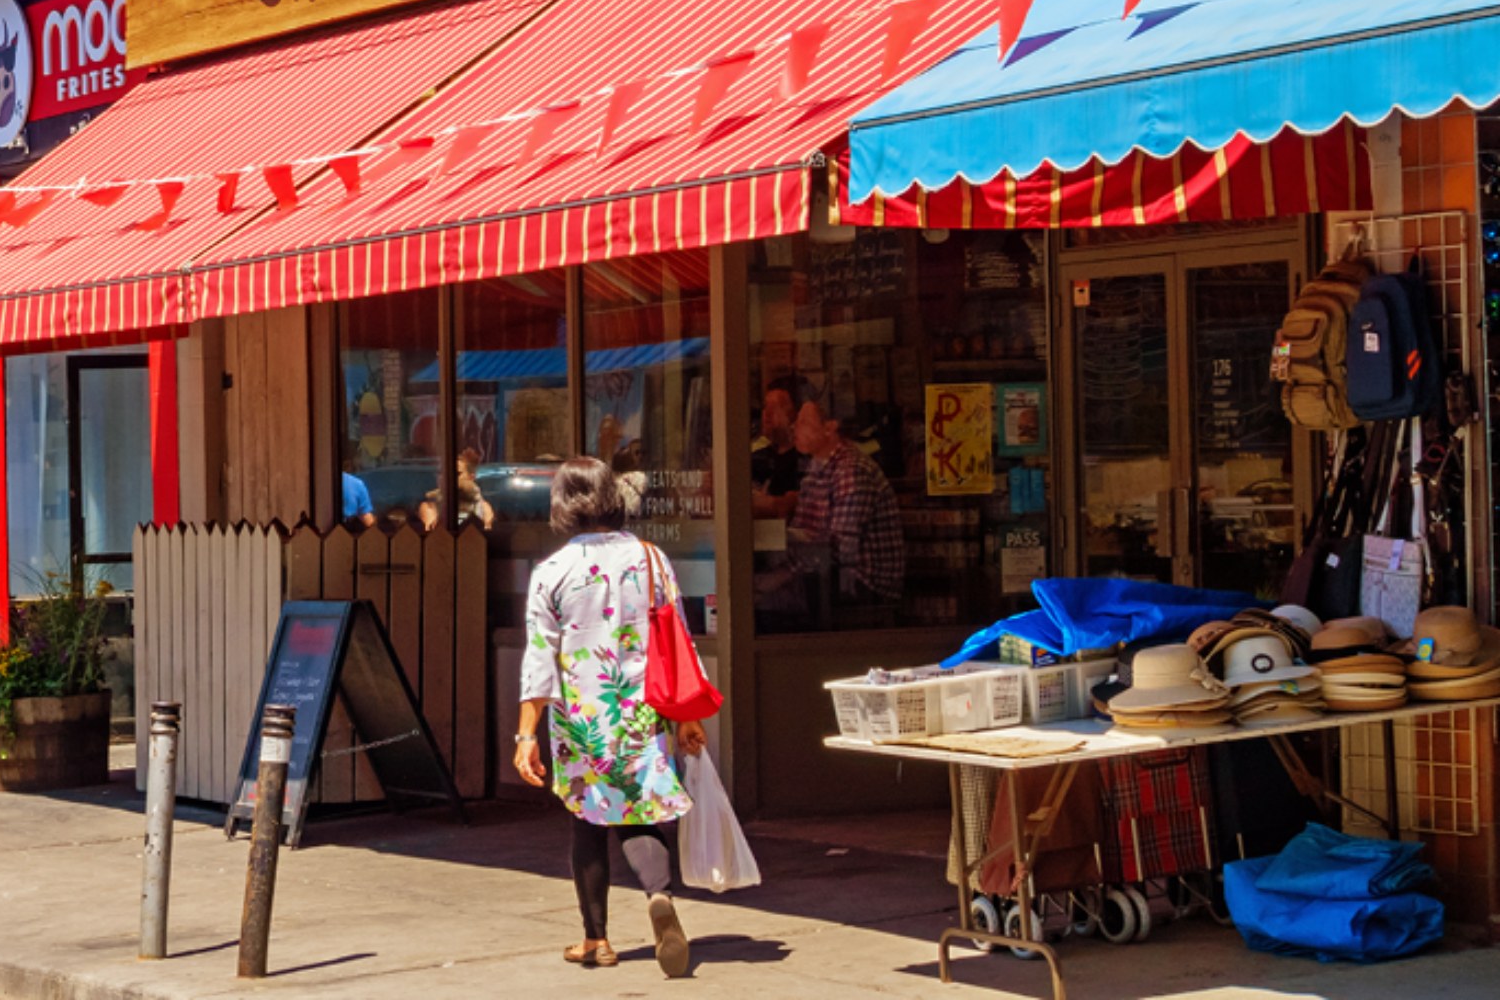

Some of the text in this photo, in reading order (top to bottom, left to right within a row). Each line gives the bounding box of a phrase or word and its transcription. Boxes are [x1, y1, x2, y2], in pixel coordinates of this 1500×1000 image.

[56, 63, 125, 102] FRITES
[646, 496, 676, 516] FROM
[678, 496, 714, 516] SMALL
[646, 523, 681, 543] FARMS
[1006, 531, 1041, 547] PASS
